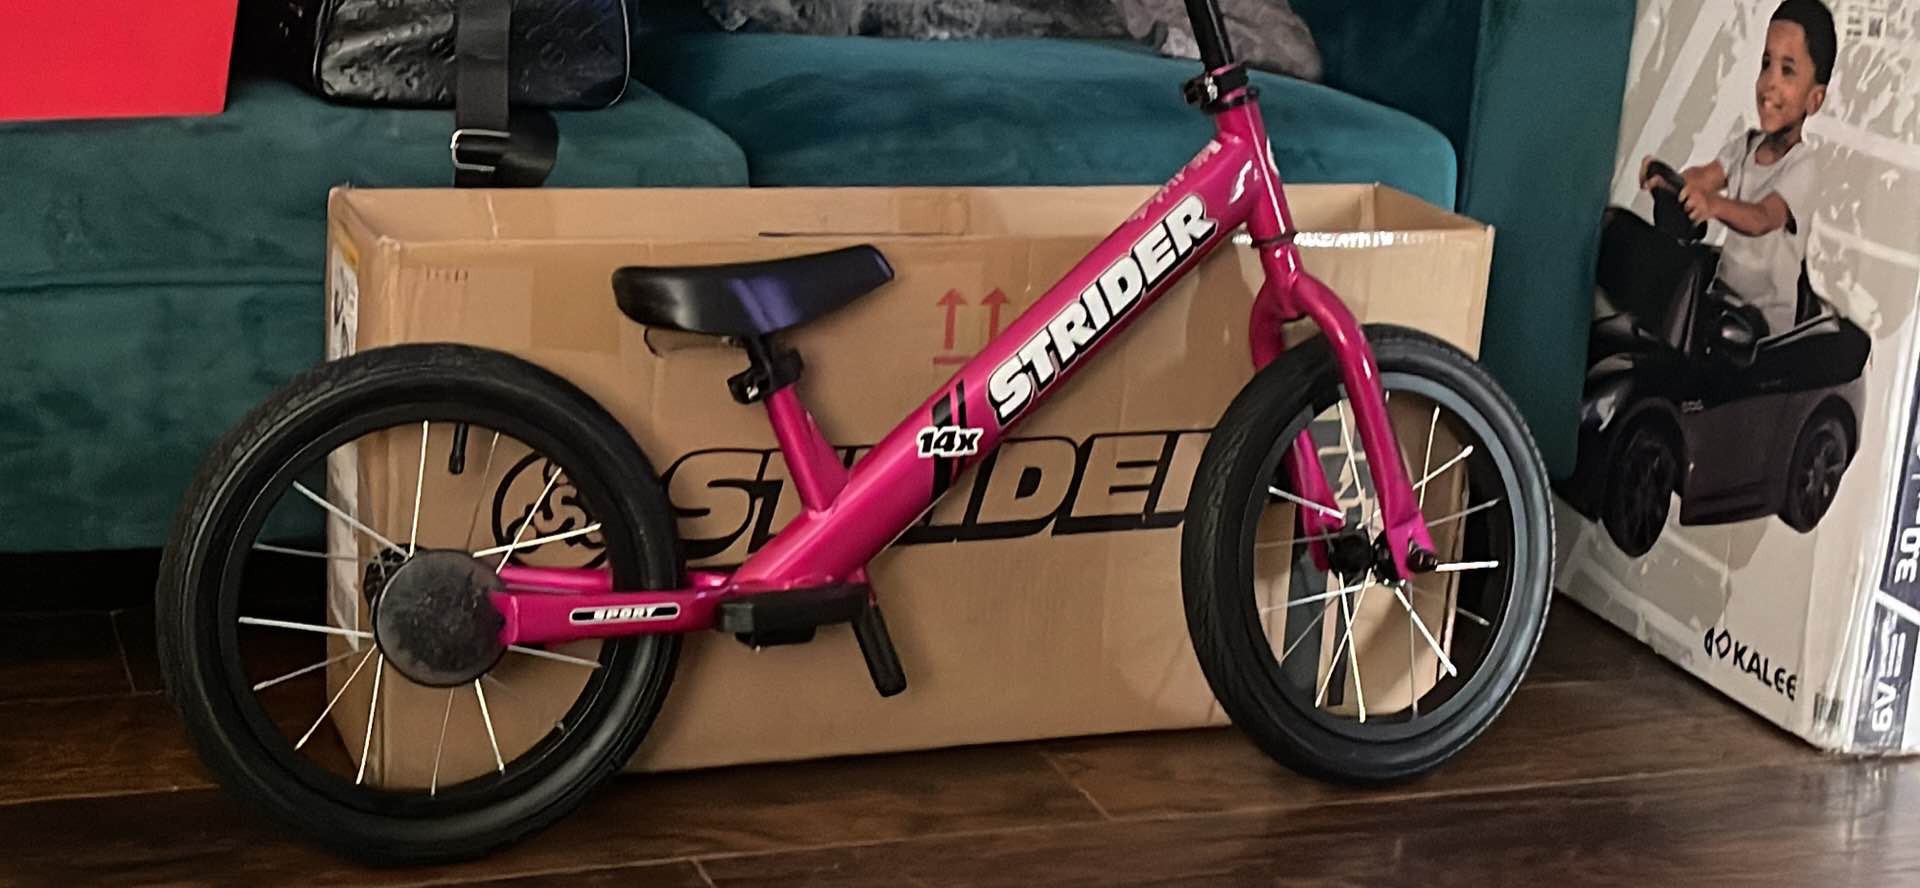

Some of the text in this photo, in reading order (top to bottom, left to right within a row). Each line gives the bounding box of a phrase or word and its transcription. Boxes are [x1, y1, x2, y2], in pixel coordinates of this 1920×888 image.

[988, 195, 1217, 422] STRIDER
[594, 607, 657, 621] SPORT
[1733, 640, 1797, 702] KALEE
